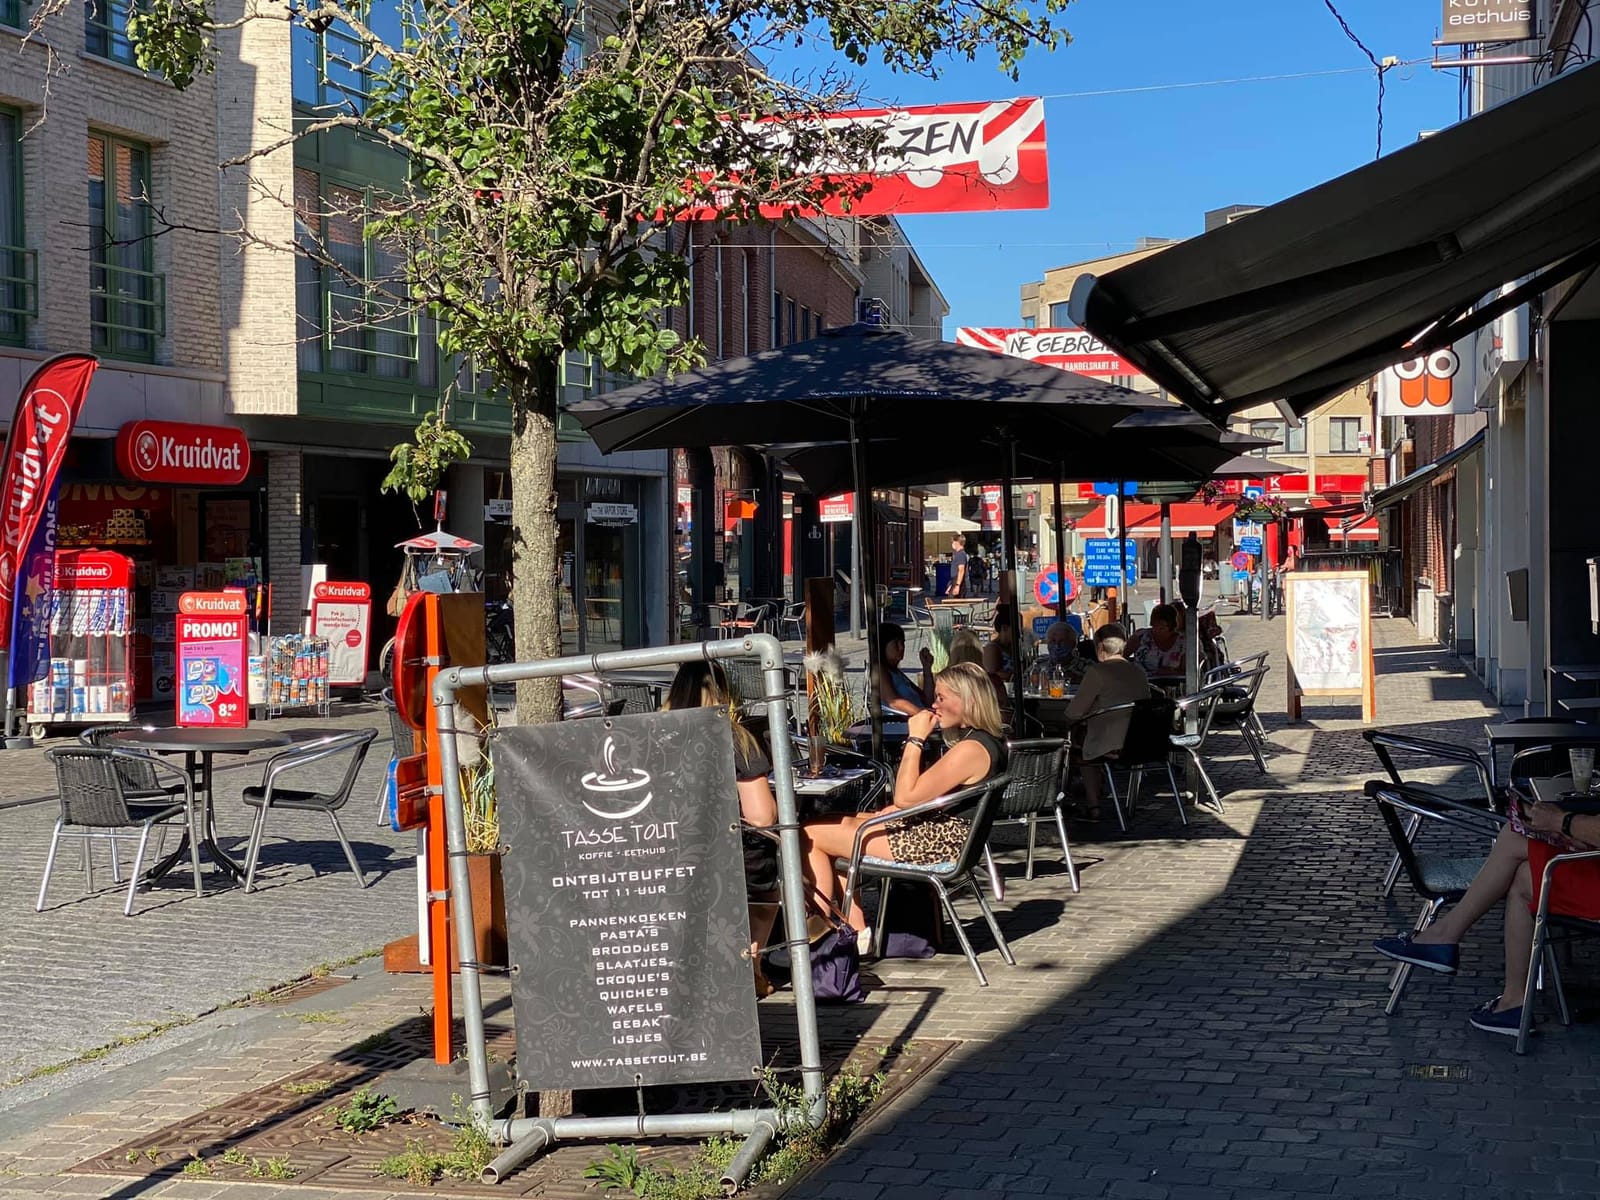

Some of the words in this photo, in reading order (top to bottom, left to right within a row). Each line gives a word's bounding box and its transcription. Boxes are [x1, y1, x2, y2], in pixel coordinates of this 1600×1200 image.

[1449, 8, 1531, 25] eethuis
[162, 436, 241, 470] Kruidvat
[5, 404, 62, 546] Kruidvat
[65, 566, 108, 577] Kruidvat
[328, 585, 366, 596] Kruidvat
[195, 598, 241, 610] Kruidvat
[183, 622, 238, 638] PROMO!
[218, 703, 237, 717] 8.99
[561, 826, 628, 848] TASSE
[630, 821, 679, 843] TOUT
[578, 851, 613, 861] KOFFIE
[624, 846, 666, 857] EETHUIS
[552, 866, 696, 888] ONTBIJTBUFFET
[582, 889, 609, 899] TOT
[615, 888, 630, 897] 11
[637, 885, 667, 896] UUR
[569, 911, 687, 928] PANNENKOEKEN
[600, 928, 659, 941] PASTA'S
[592, 942, 669, 956] BROODJES
[596, 957, 668, 971] SLAATJES
[596, 972, 670, 986] CROQUE'S
[599, 987, 669, 1001] QUICHE'S
[607, 1003, 663, 1015] WAFELS
[612, 1018, 661, 1030] GEBAK
[612, 1033, 662, 1045] IJSJES
[571, 1053, 708, 1069] WWW.TASSETOUT.BE
